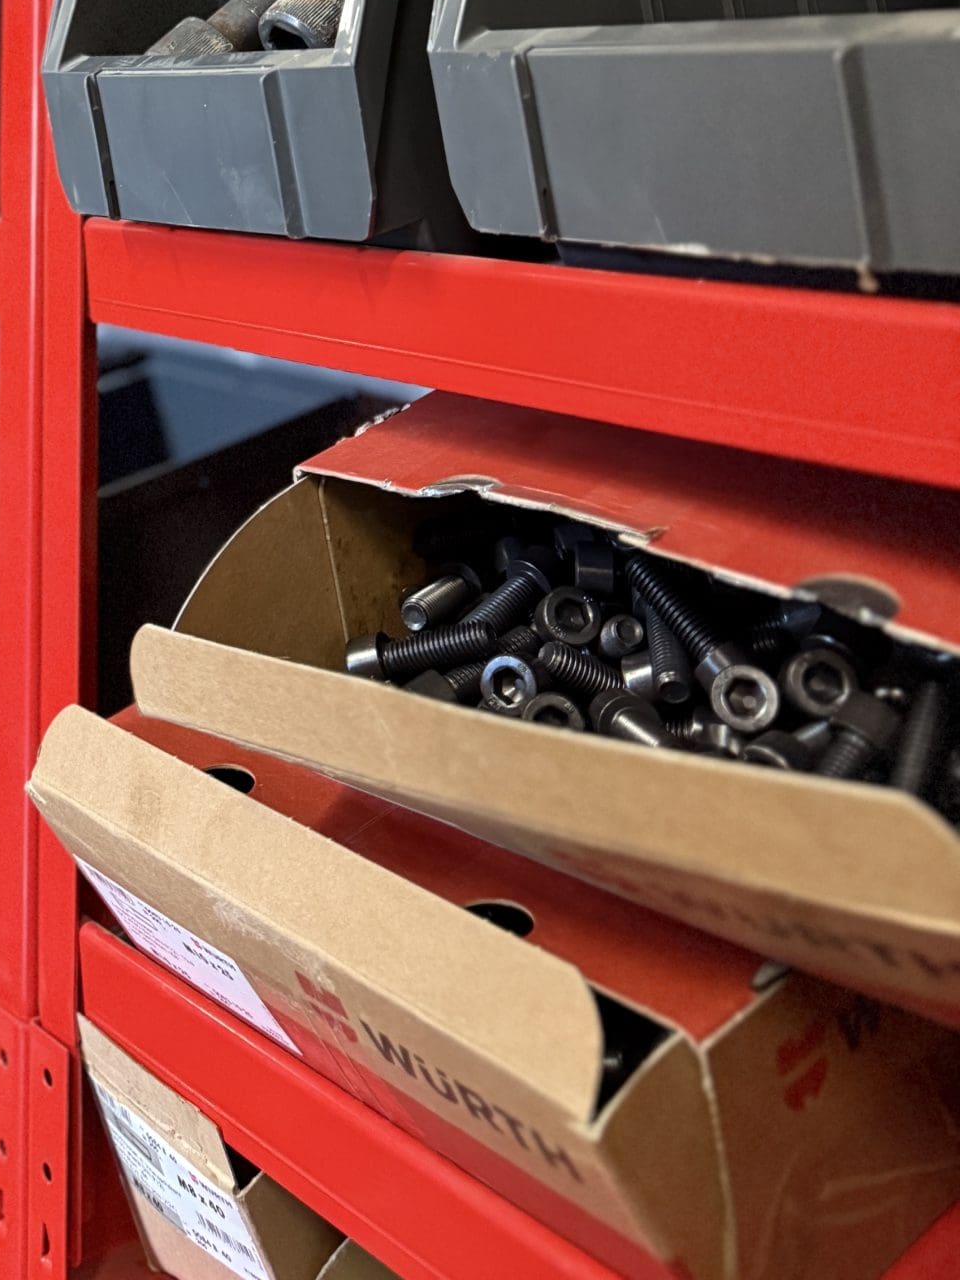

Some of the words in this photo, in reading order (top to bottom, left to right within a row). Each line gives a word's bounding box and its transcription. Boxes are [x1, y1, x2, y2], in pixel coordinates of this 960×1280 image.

[358, 1016, 584, 1184] WÜRTH
[177, 1174, 197, 1198] M8
[208, 1199, 226, 1219] 40
